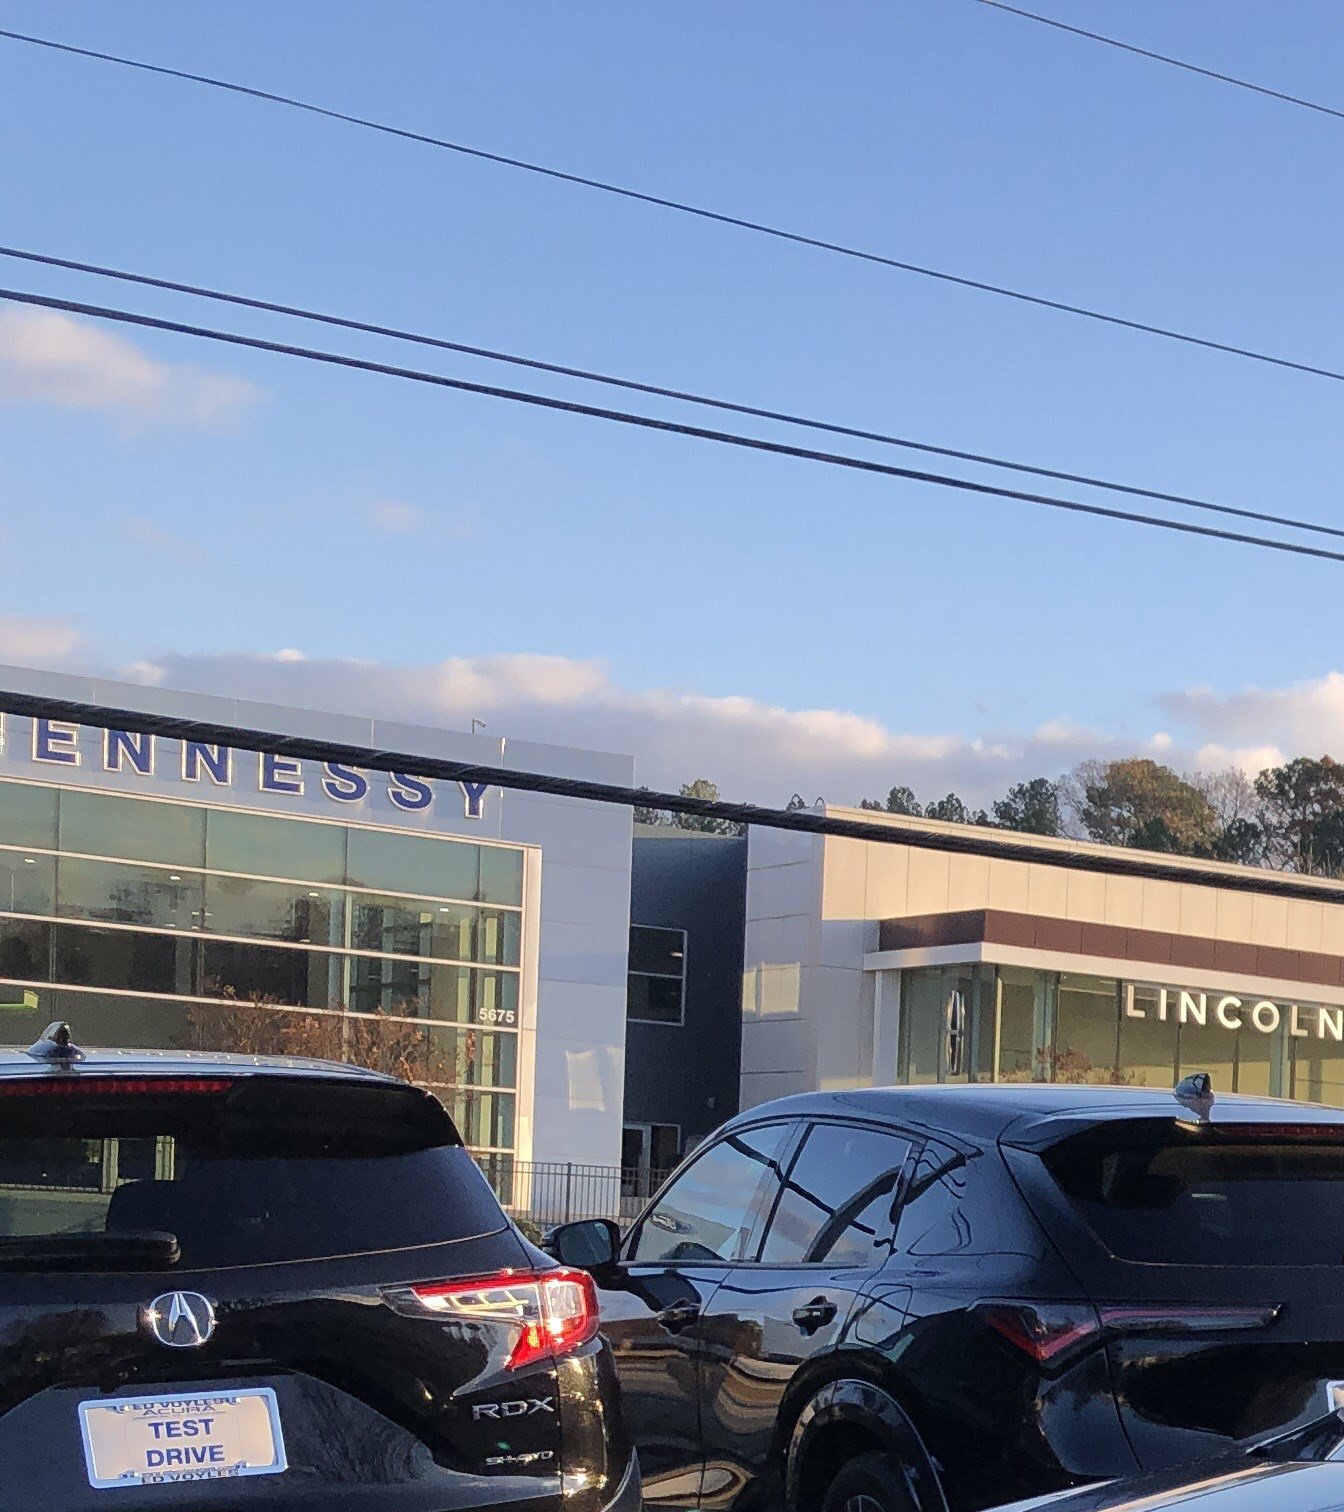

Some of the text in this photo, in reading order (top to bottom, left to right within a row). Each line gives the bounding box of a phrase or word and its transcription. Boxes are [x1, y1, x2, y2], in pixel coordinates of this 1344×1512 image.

[0, 712, 489, 819] ENNESSY
[479, 1006, 515, 1024] 5675
[1126, 984, 1344, 1042] LINCOLN
[472, 1396, 555, 1420] RDX
[147, 1418, 215, 1439] TEST
[146, 1444, 226, 1468] DRIVE
